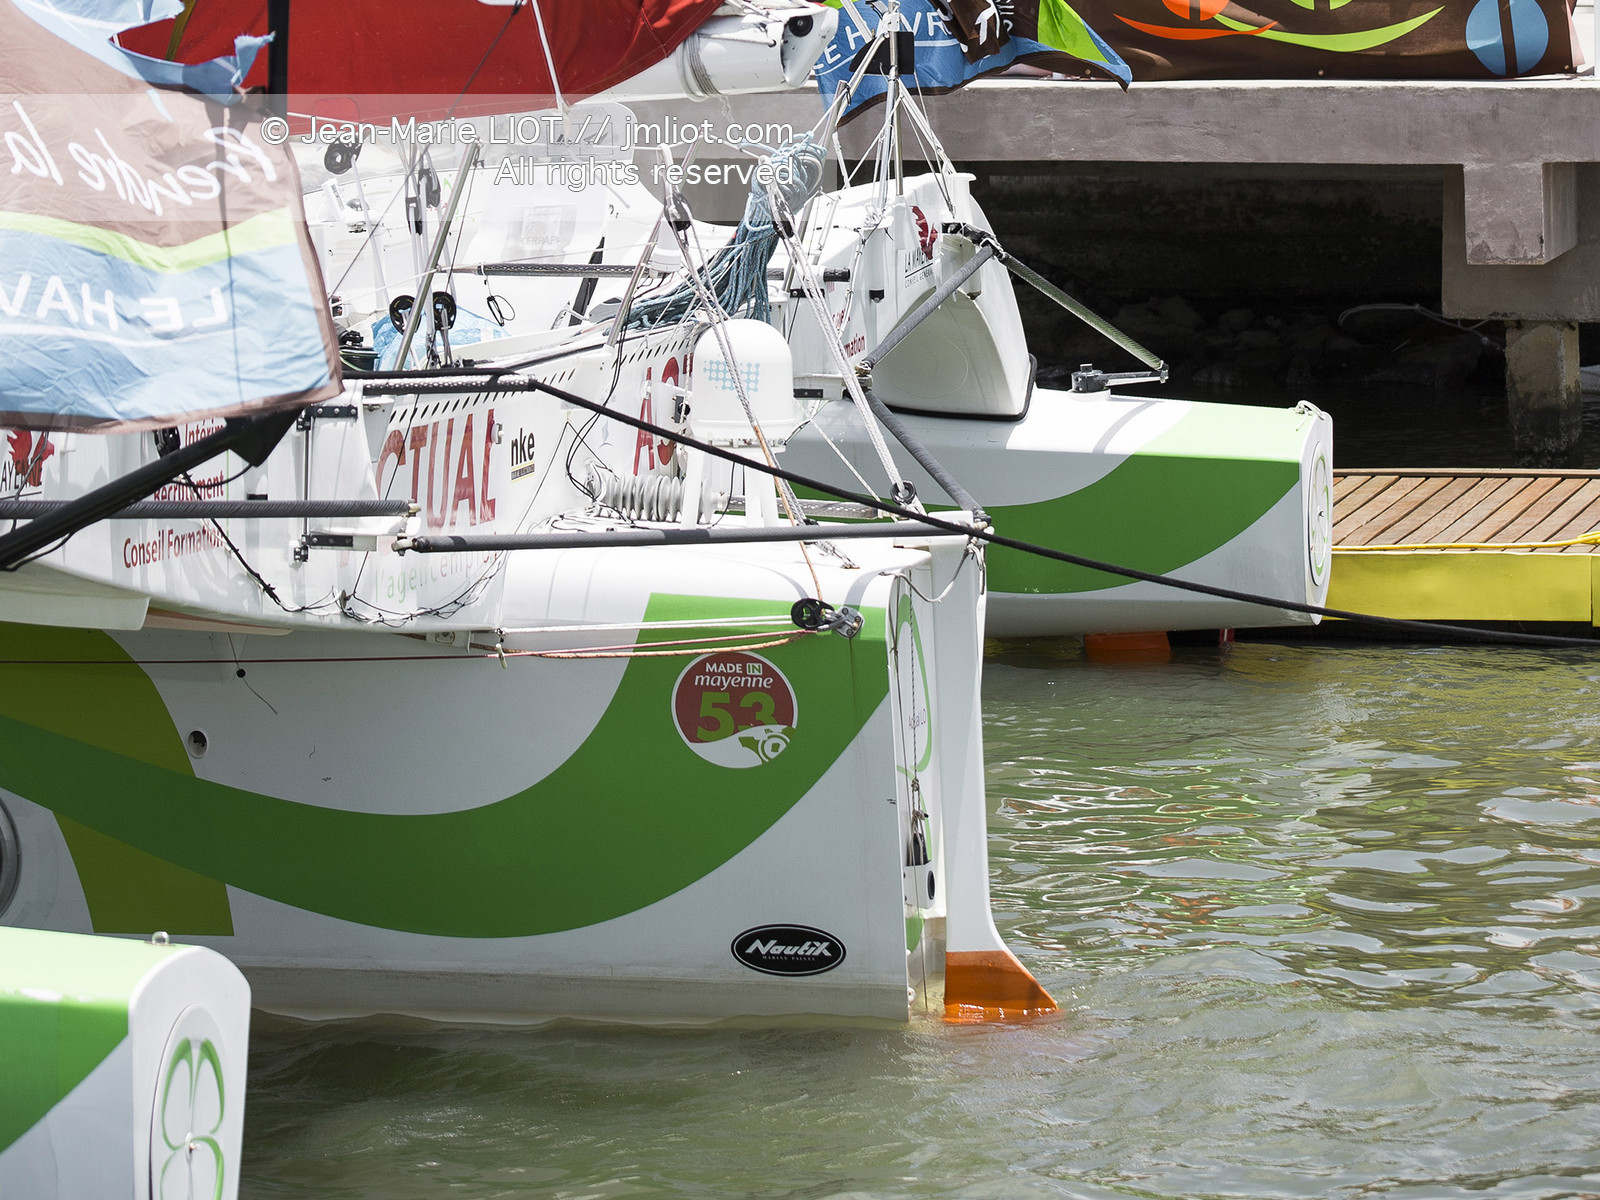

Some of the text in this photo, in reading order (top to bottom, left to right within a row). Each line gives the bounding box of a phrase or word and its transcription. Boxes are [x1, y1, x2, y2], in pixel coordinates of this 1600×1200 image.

[511, 428, 535, 466] nke
[376, 409, 496, 537] CTUAL
[123, 522, 224, 569] Conseil Formation
[694, 674, 774, 691] mayenne
[705, 662, 762, 675] MADE IN
[697, 691, 778, 742] 53
